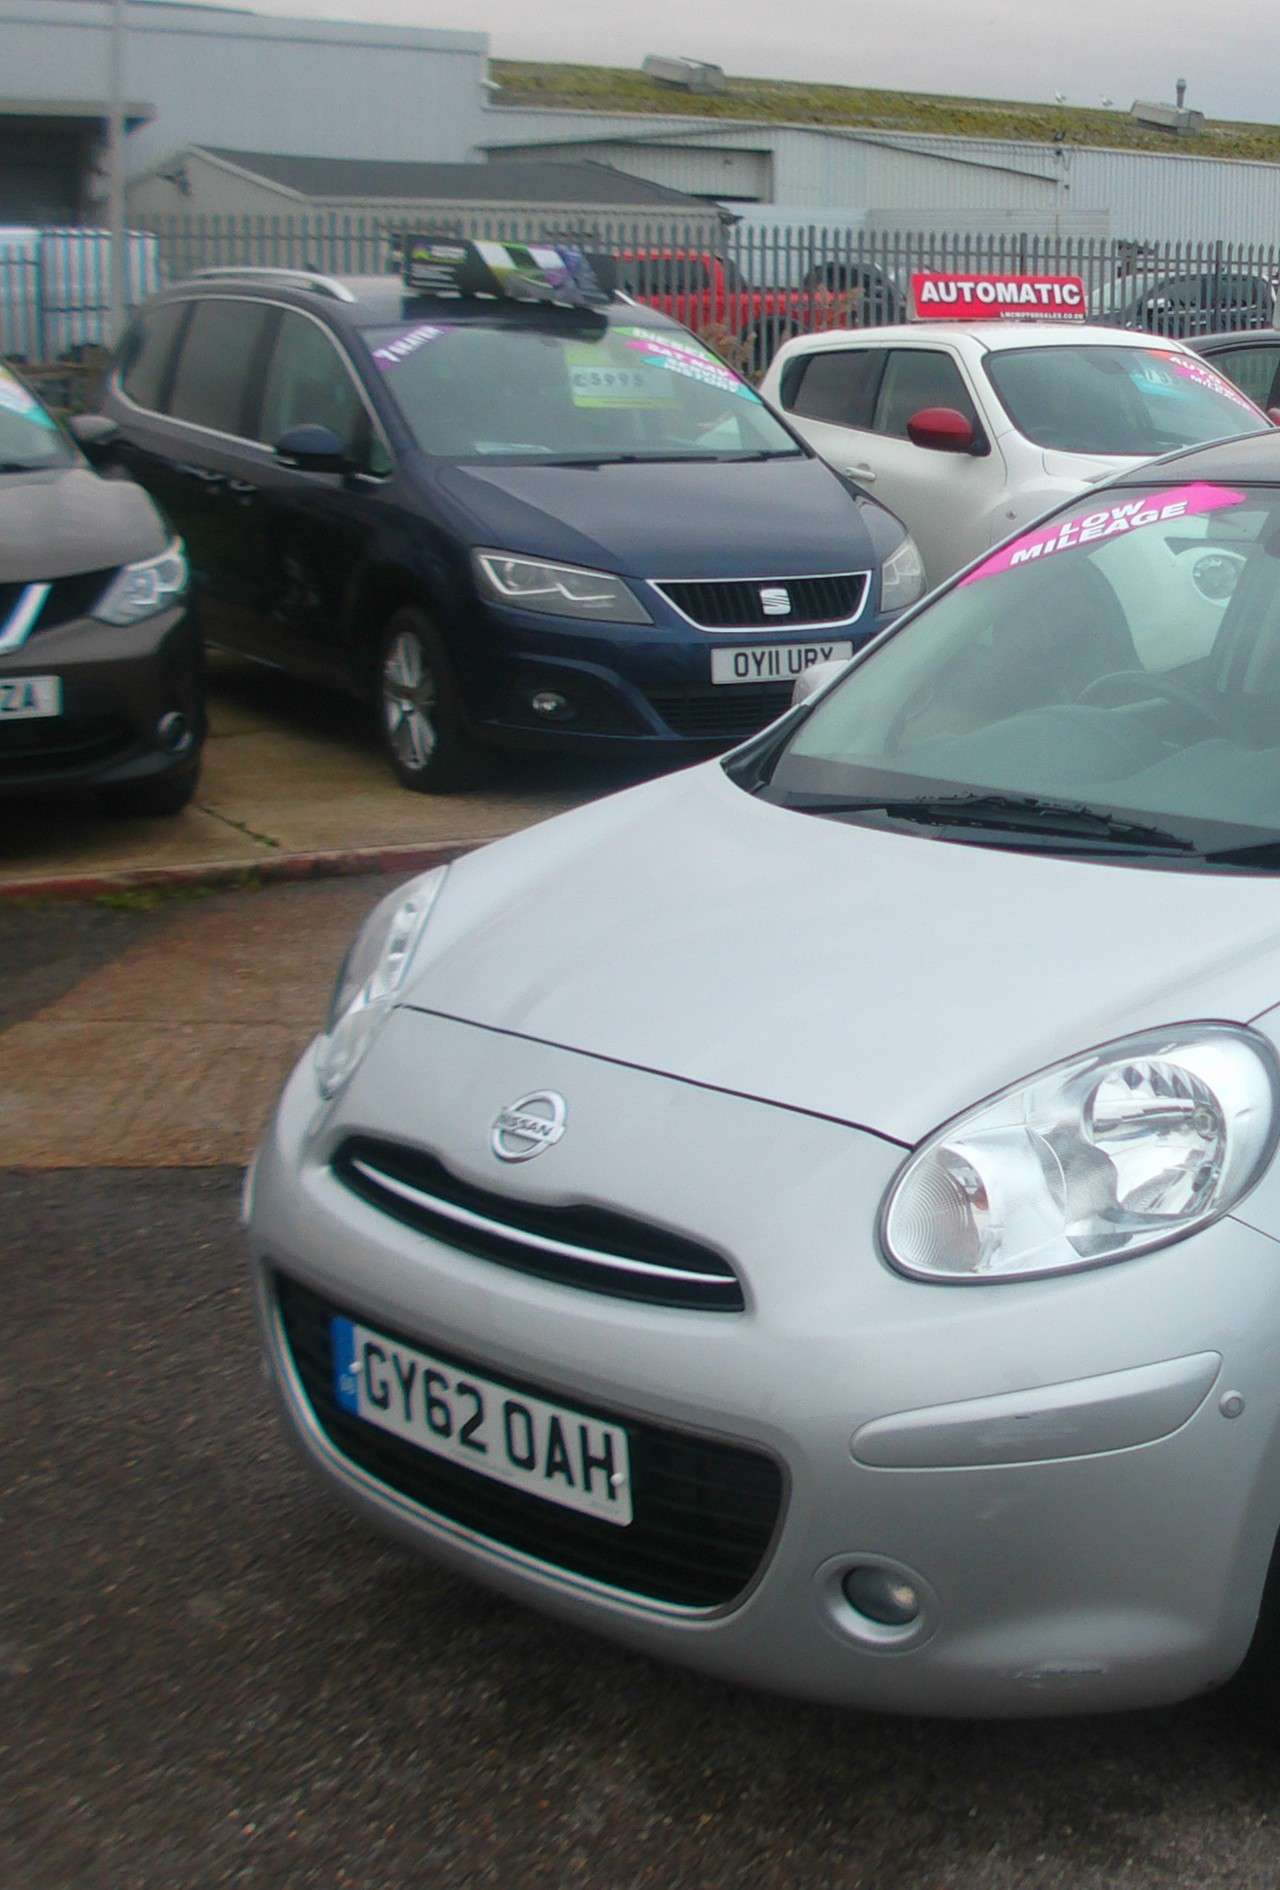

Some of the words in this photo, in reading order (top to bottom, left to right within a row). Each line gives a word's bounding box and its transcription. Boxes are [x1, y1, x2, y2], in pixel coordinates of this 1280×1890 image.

[920, 280, 1081, 306] AUTOMATIC
[1010, 501, 1189, 565] MILEAGE
[1059, 500, 1147, 536] LOW
[363, 1341, 488, 1454] GY62
[503, 1400, 617, 1501] OAH
